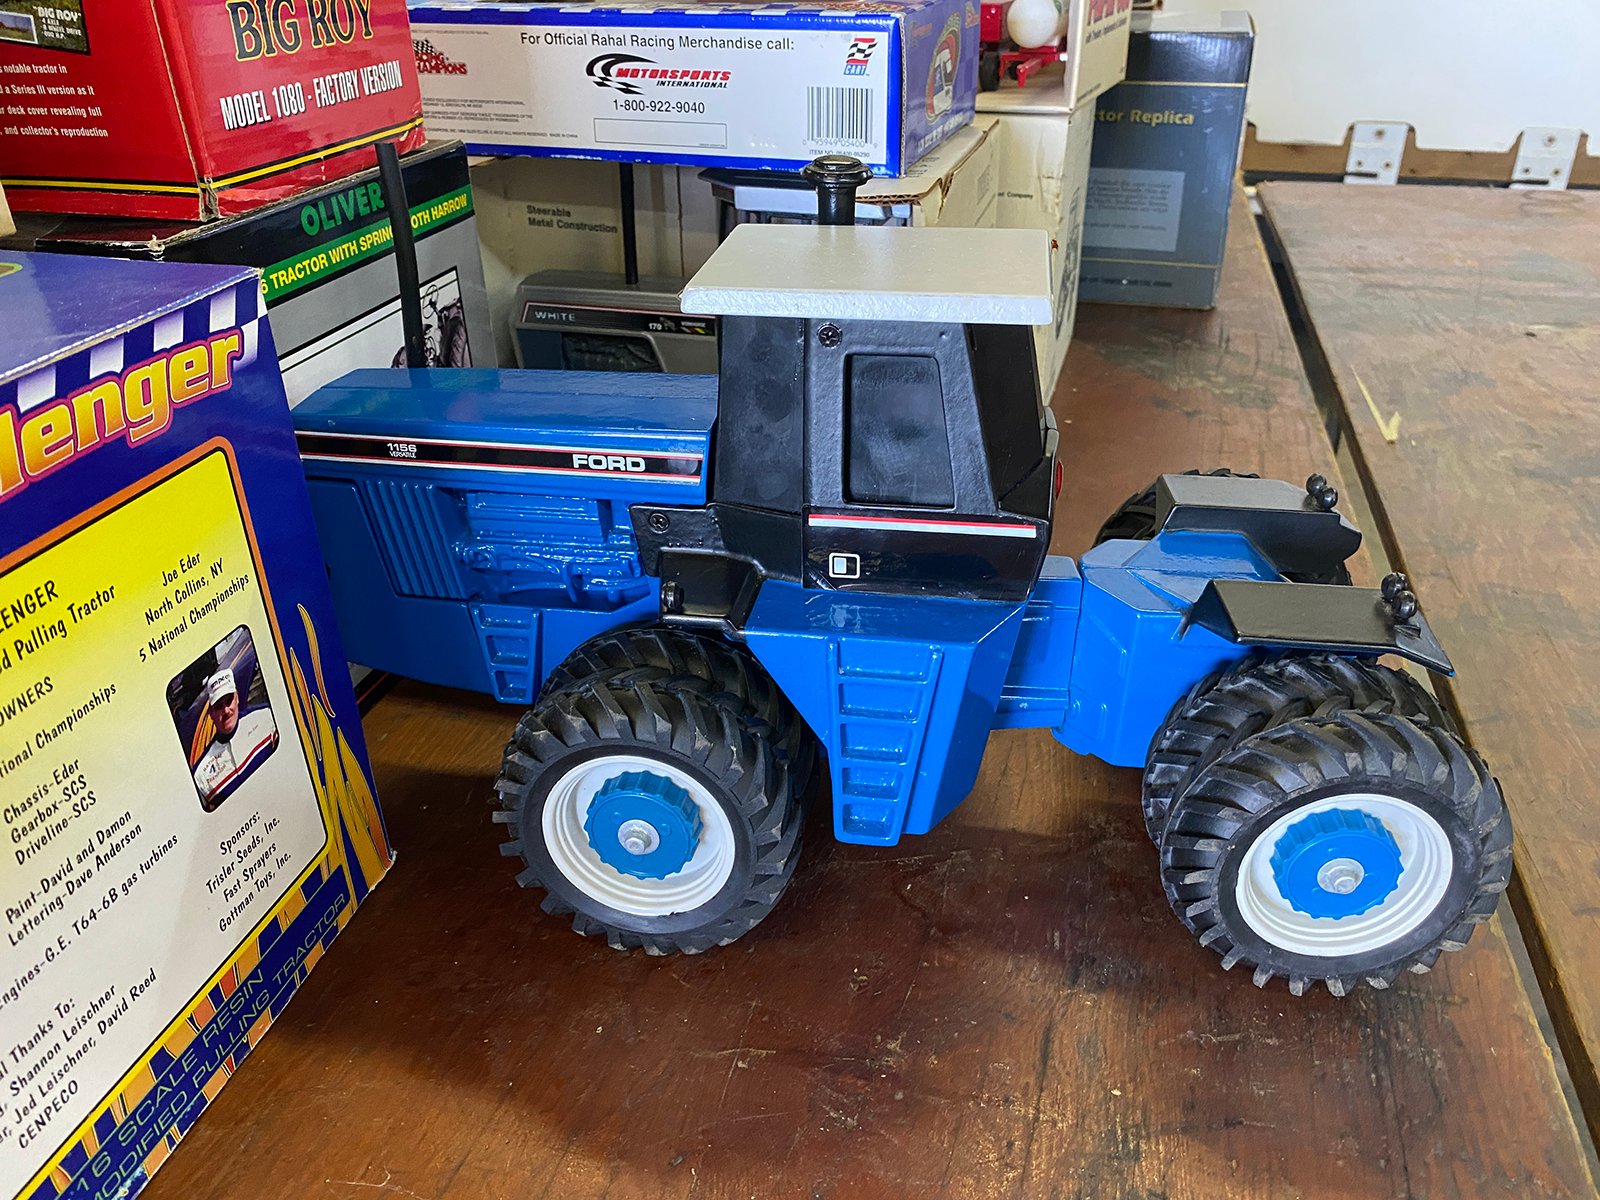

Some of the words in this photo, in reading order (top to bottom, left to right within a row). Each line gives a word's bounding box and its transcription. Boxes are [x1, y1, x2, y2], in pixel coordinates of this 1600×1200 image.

[225, 0, 302, 61] BIG
[305, 0, 374, 48] ROY
[520, 32, 540, 46] For
[544, 33, 587, 46] Official
[591, 34, 627, 47] Rahal
[630, 34, 675, 50] Racing
[679, 35, 762, 50] Merchandise
[766, 38, 795, 50] call:
[3, 64, 32, 74] notable
[32, 64, 57, 74] tractor
[58, 64, 68, 74] in
[11, 84, 36, 95] Series
[36, 84, 46, 94] III
[47, 86, 76, 96] version
[76, 87, 86, 96] as
[88, 85, 94, 96] it
[220, 90, 271, 130] MODEL
[272, 82, 306, 119] 1080
[313, 69, 360, 108] FACTORY
[360, 60, 403, 97] VERSION
[615, 67, 732, 81] MOTORSPORTS
[656, 80, 728, 89] INTERNATIONAL
[844, 64, 867, 75] CART
[4, 126, 18, 136] and
[20, 126, 59, 136] collector's
[60, 127, 108, 138] reproduction
[7, 105, 26, 115] deck
[27, 107, 48, 116] cover
[50, 106, 87, 118] revealing
[88, 106, 102, 117] full
[613, 99, 706, 114] 1-800-922-9040
[1130, 109, 1195, 127] Replica
[301, 181, 385, 236] OLIVER
[526, 204, 571, 218] Steerable
[528, 217, 553, 228] Metal
[556, 219, 618, 234] Construction
[270, 251, 328, 290] TRACTOR
[328, 240, 358, 266] WITH
[432, 193, 468, 222] HARROW
[534, 310, 576, 322] WHITE
[648, 322, 662, 331] 170
[387, 442, 417, 452] 1156
[572, 453, 646, 472] FORD
[144, 598, 174, 626] North
[174, 572, 210, 606] Collins,
[209, 558, 224, 579] NY
[162, 568, 178, 587] Joe
[179, 552, 201, 576] Eder
[14, 619, 68, 661] Pulling
[67, 585, 116, 624] Tractor
[139, 648, 147, 663] 5
[148, 618, 188, 655] National
[189, 573, 250, 625] Championships
[36, 684, 117, 749] Championships
[3, 758, 80, 825] Chassis-Eder
[10, 774, 89, 844] Gearbox-SCS
[14, 790, 98, 866] Driveline-SCS
[205, 860, 236, 895] Trisler
[236, 834, 266, 865] Seeds,
[264, 816, 281, 834] Inc.
[219, 810, 262, 856] Sponsors:
[5, 856, 74, 925] Paint-David
[76, 837, 96, 865] and
[96, 810, 132, 844] Damon
[7, 864, 93, 947] Lettering-Dave
[96, 823, 142, 871] Anderson
[72, 889, 119, 937] T64-6B
[121, 871, 140, 898] gas
[139, 833, 179, 874] turbines
[218, 892, 254, 933] Gottman
[254, 870, 276, 895] Toys,
[276, 853, 292, 871] Inc.
[223, 878, 242, 903] Fast
[242, 843, 278, 883] Sprayers
[192, 988, 271, 1088] PULLING
[272, 892, 346, 986] TRACTOR
[9, 1018, 54, 1064] Thanks
[54, 997, 76, 1020] To:
[9, 1042, 62, 1098] Shannon
[62, 984, 116, 1043] Leischner
[15, 1093, 38, 1125] Jed
[37, 1036, 97, 1099] Leischner,
[97, 998, 129, 1036] David
[129, 967, 158, 1002] Reed
[117, 1047, 200, 1148] SCALE
[202, 968, 264, 1048] RESIN
[18, 1079, 80, 1150] CENPECO
